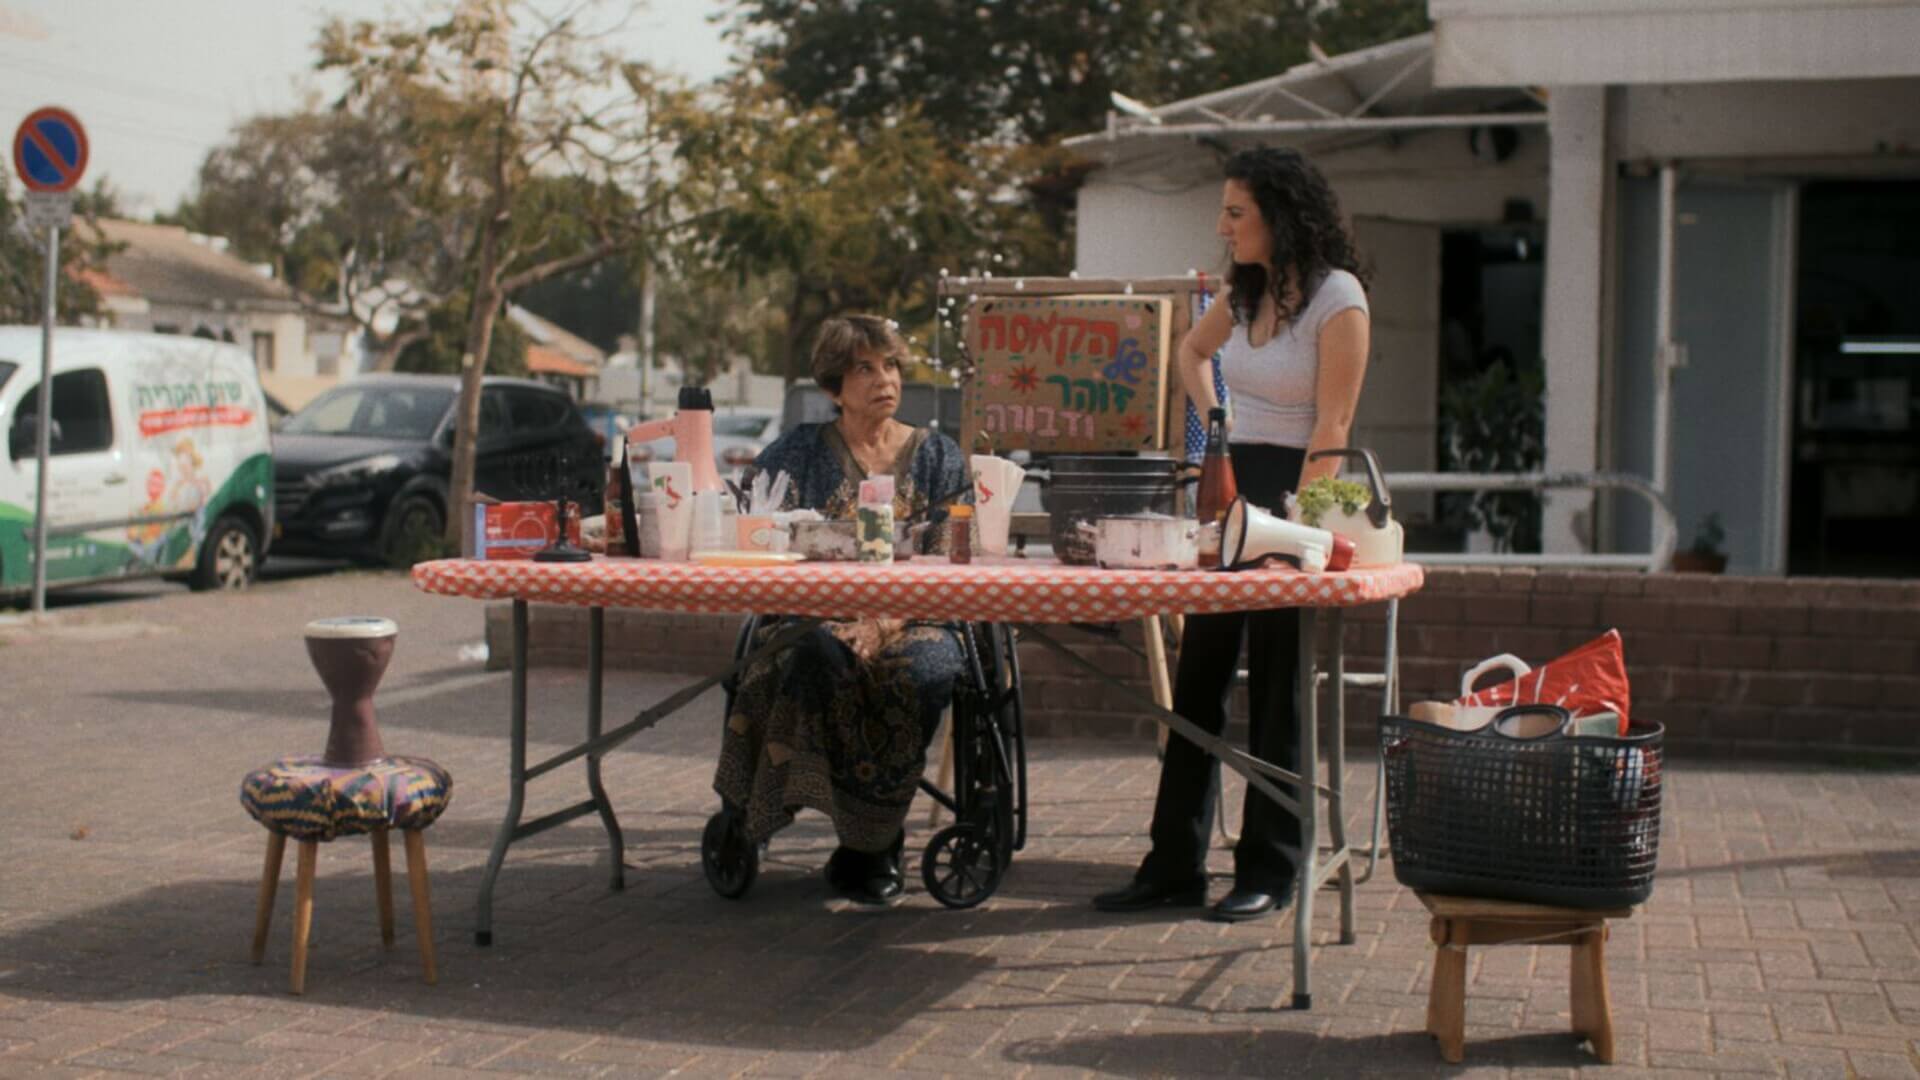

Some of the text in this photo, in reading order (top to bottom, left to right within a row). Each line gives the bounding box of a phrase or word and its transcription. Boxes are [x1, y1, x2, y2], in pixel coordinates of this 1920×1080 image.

[978, 312, 1147, 384] הקאסה של
[204, 381, 242, 408] שוק
[1045, 374, 1136, 415] זוהר
[984, 403, 1095, 440] ודבורה
